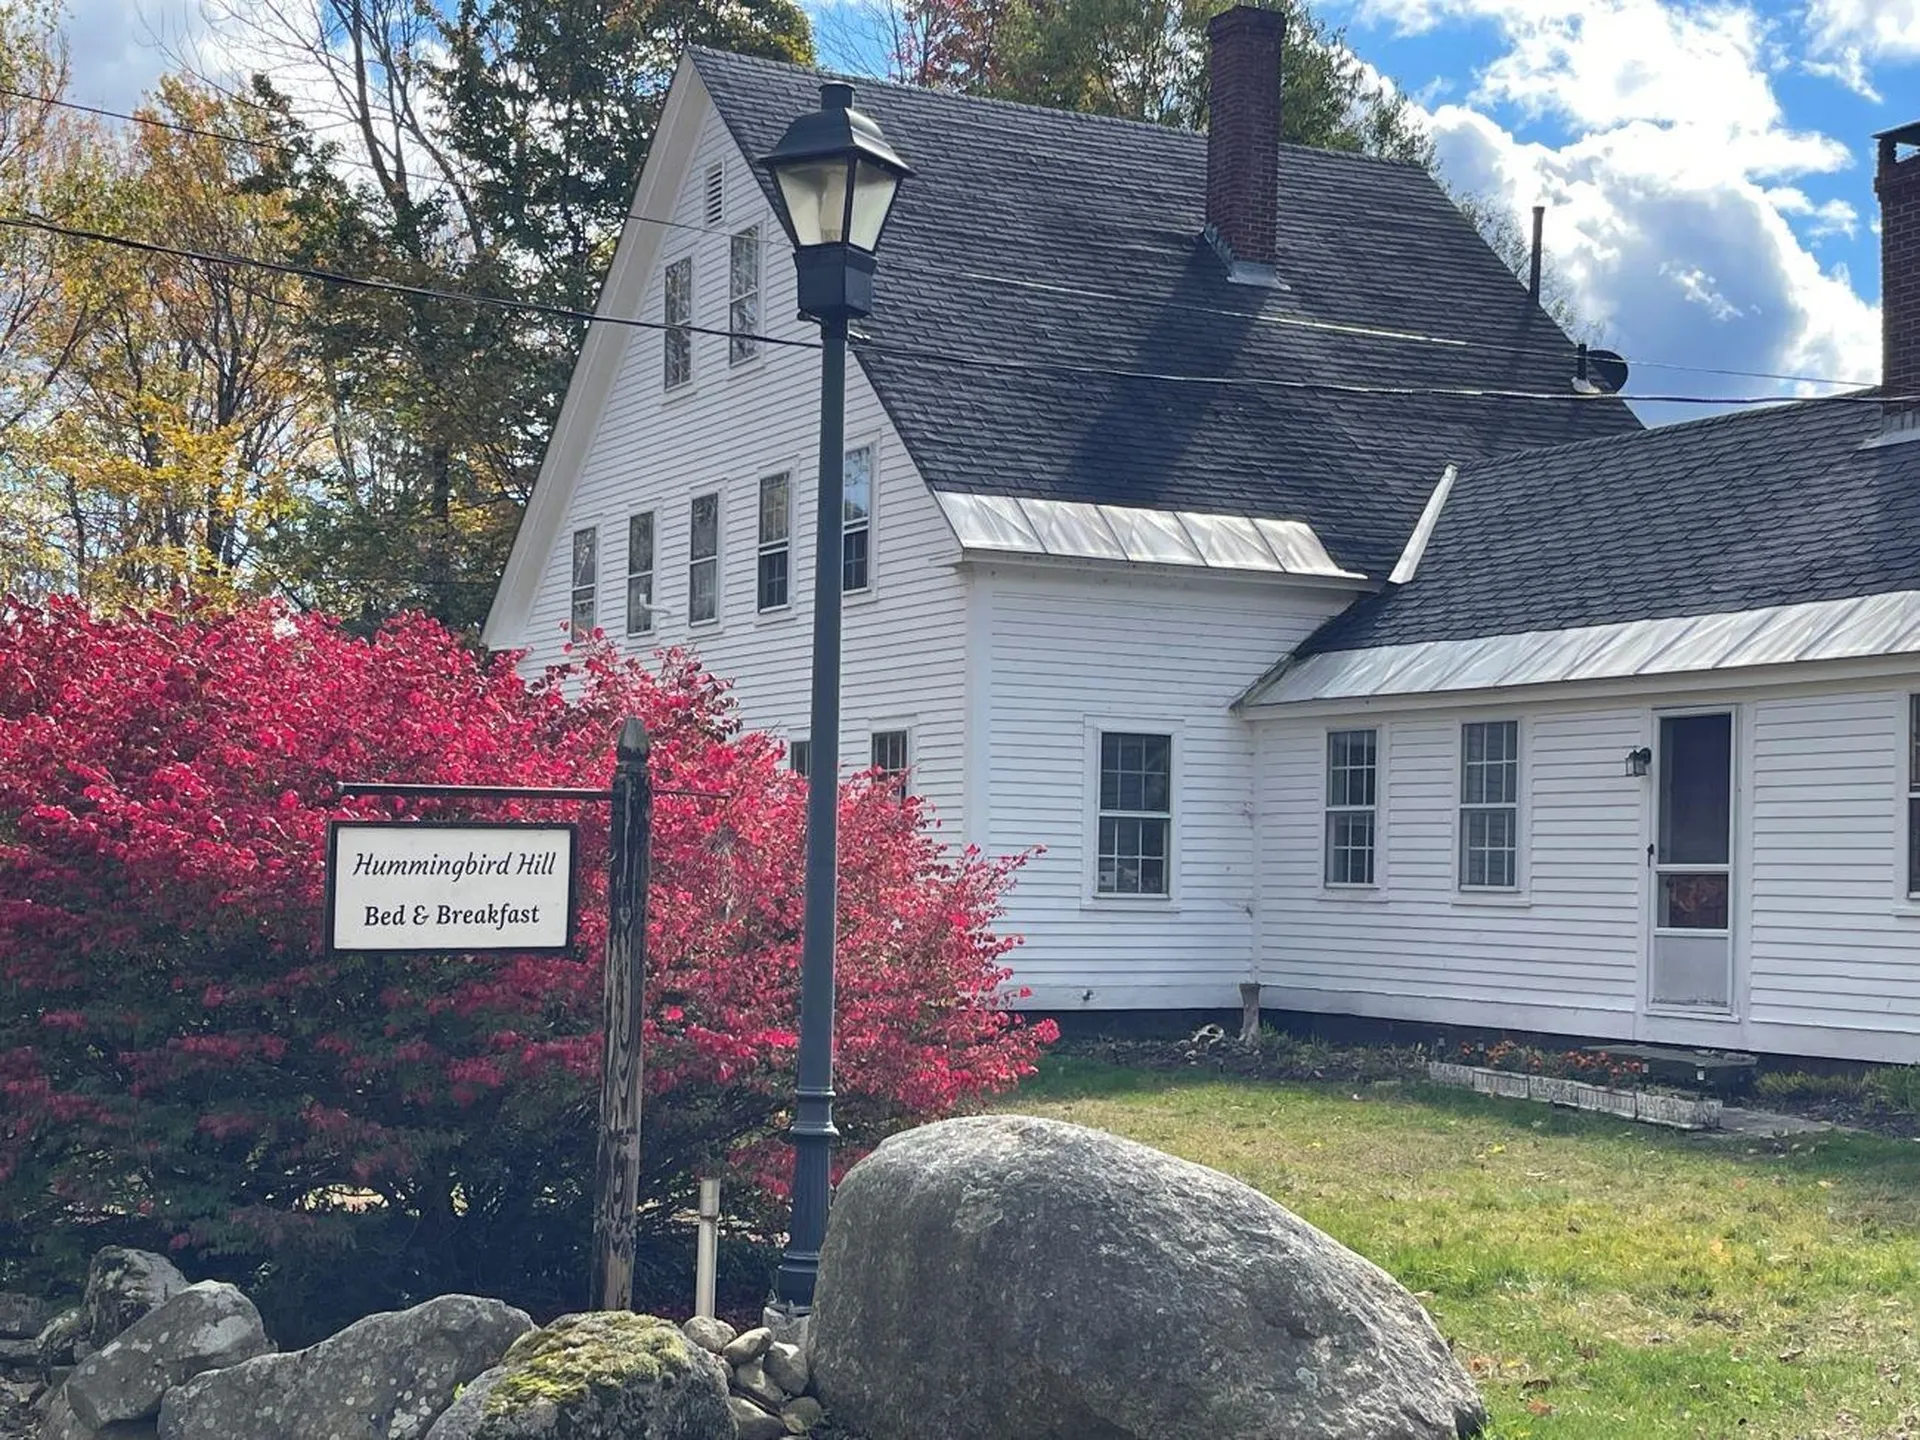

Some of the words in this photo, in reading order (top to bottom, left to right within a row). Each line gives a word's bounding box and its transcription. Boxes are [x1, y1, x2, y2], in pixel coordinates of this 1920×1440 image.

[353, 852, 513, 882] Hummingbird
[517, 852, 556, 875] Hill
[364, 905, 406, 926] Bed
[413, 905, 429, 925] &
[436, 903, 540, 930] Breakfast
